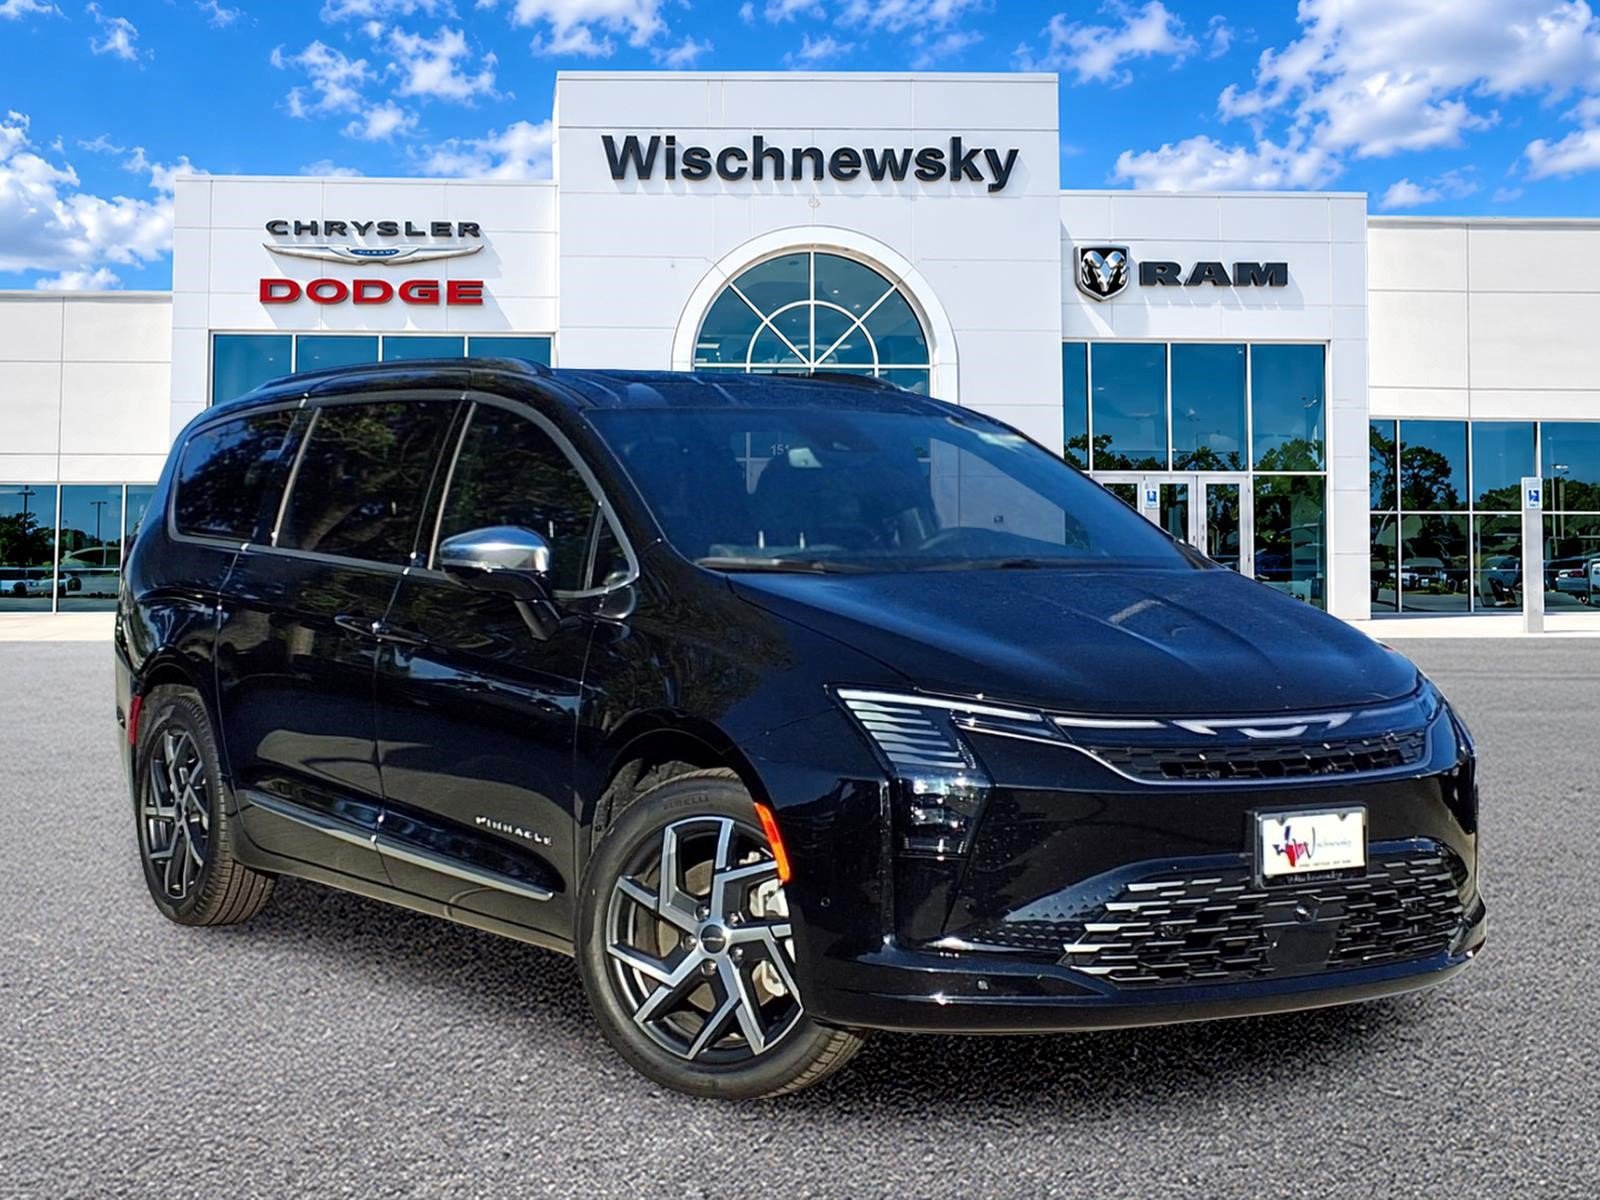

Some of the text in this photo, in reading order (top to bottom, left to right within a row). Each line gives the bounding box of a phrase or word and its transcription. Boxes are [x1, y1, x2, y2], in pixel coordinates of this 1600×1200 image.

[601, 135, 1019, 192] Wischnewsky
[265, 220, 481, 237] CHRYSLER
[1139, 261, 1288, 286] RAM
[259, 278, 484, 305] DODGE
[475, 816, 552, 846] PINNACLE
